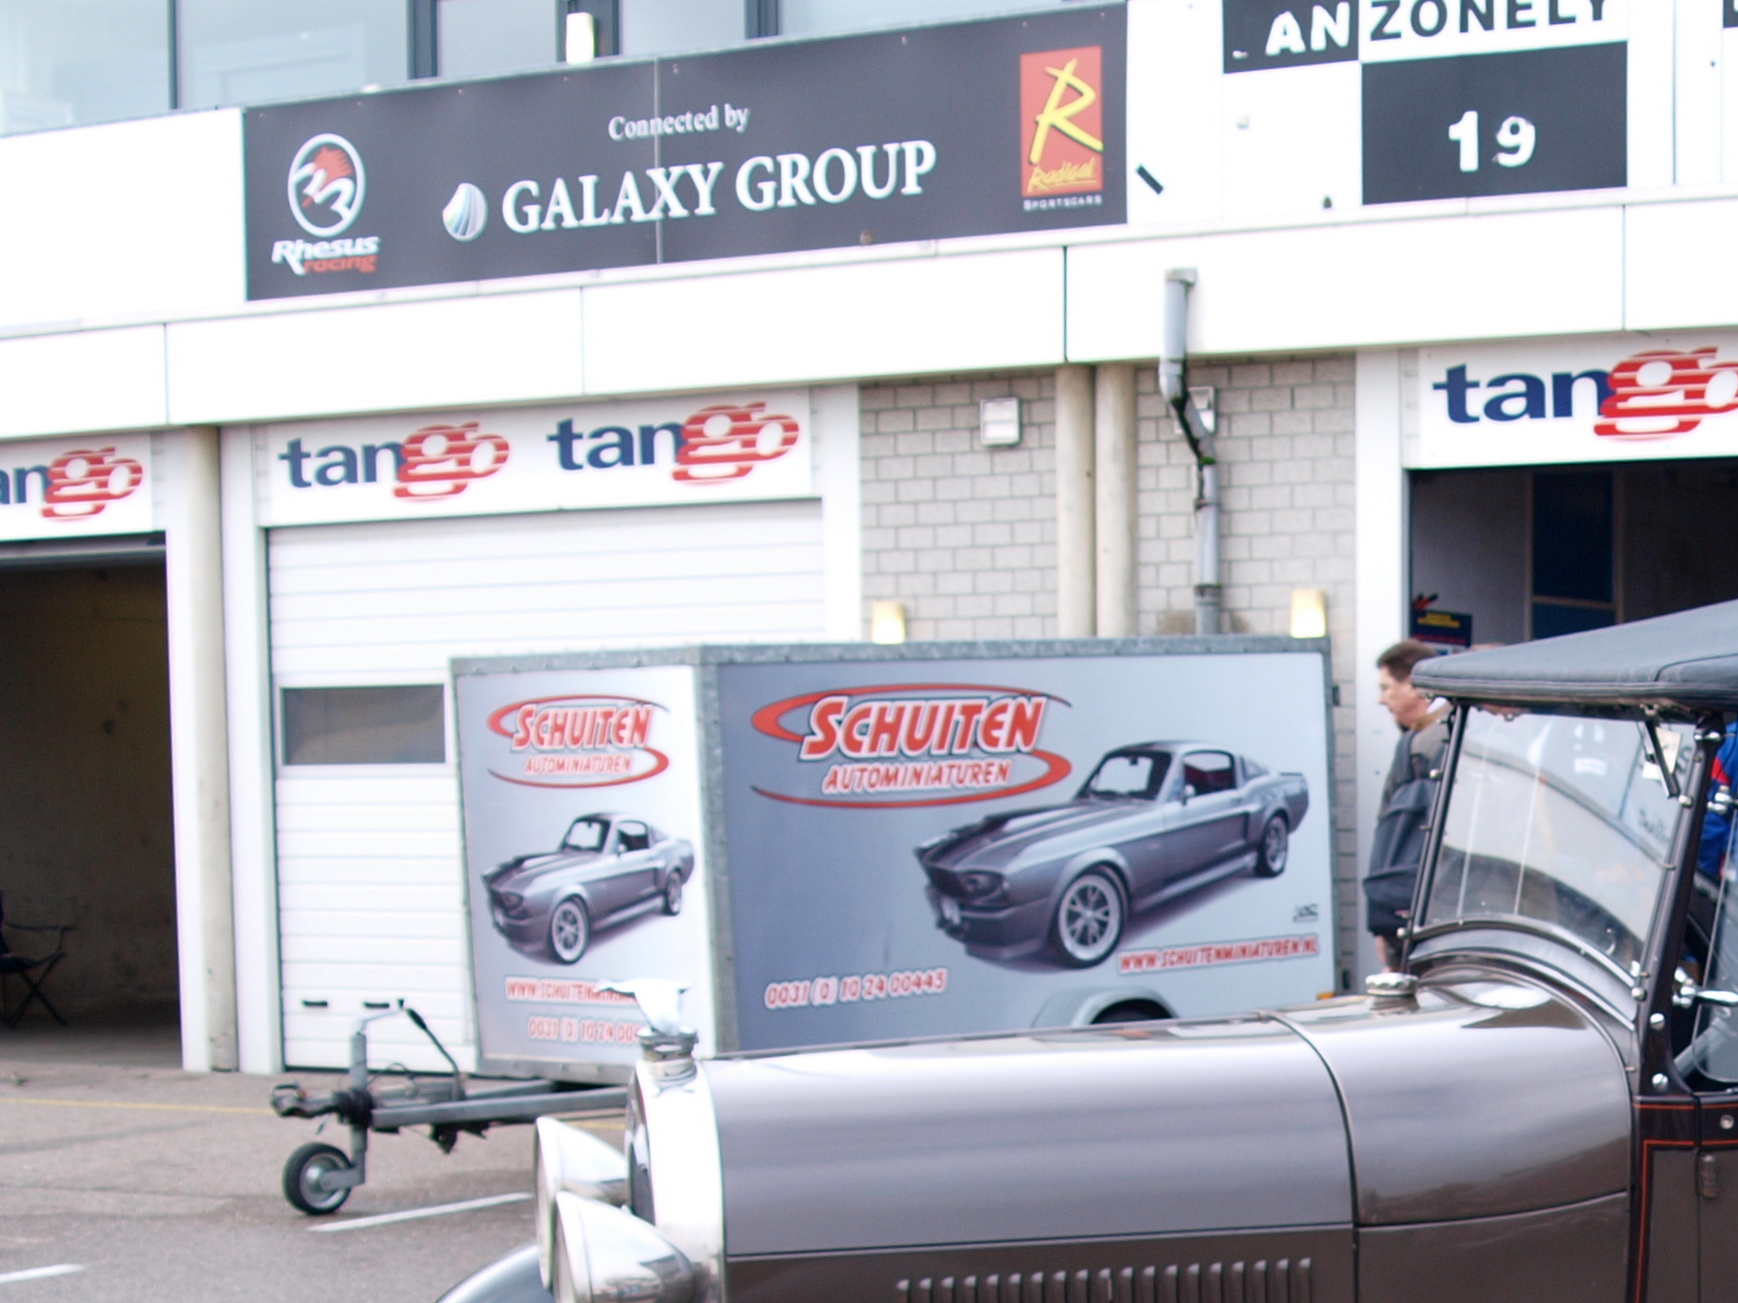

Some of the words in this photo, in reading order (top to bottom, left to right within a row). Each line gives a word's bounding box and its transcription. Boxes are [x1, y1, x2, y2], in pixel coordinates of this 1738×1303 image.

[608, 105, 720, 141] Connected
[724, 103, 750, 133] by
[1448, 110, 1536, 173] 19
[502, 162, 724, 233] GALAXY
[735, 140, 937, 211] GROUP
[272, 236, 380, 275] Rhesus
[303, 254, 378, 274] racing
[278, 421, 510, 501] tango
[546, 401, 799, 484] tango
[511, 704, 653, 751] SCHUITEN
[799, 695, 1047, 760] SCHUITEN
[525, 754, 633, 775] AUTOMINIATUREN
[824, 761, 1011, 794] AUTOMINIATUREN
[766, 981, 810, 1008] 0031
[841, 977, 861, 1001] 10
[863, 975, 887, 999] 24
[889, 969, 947, 996] 00445
